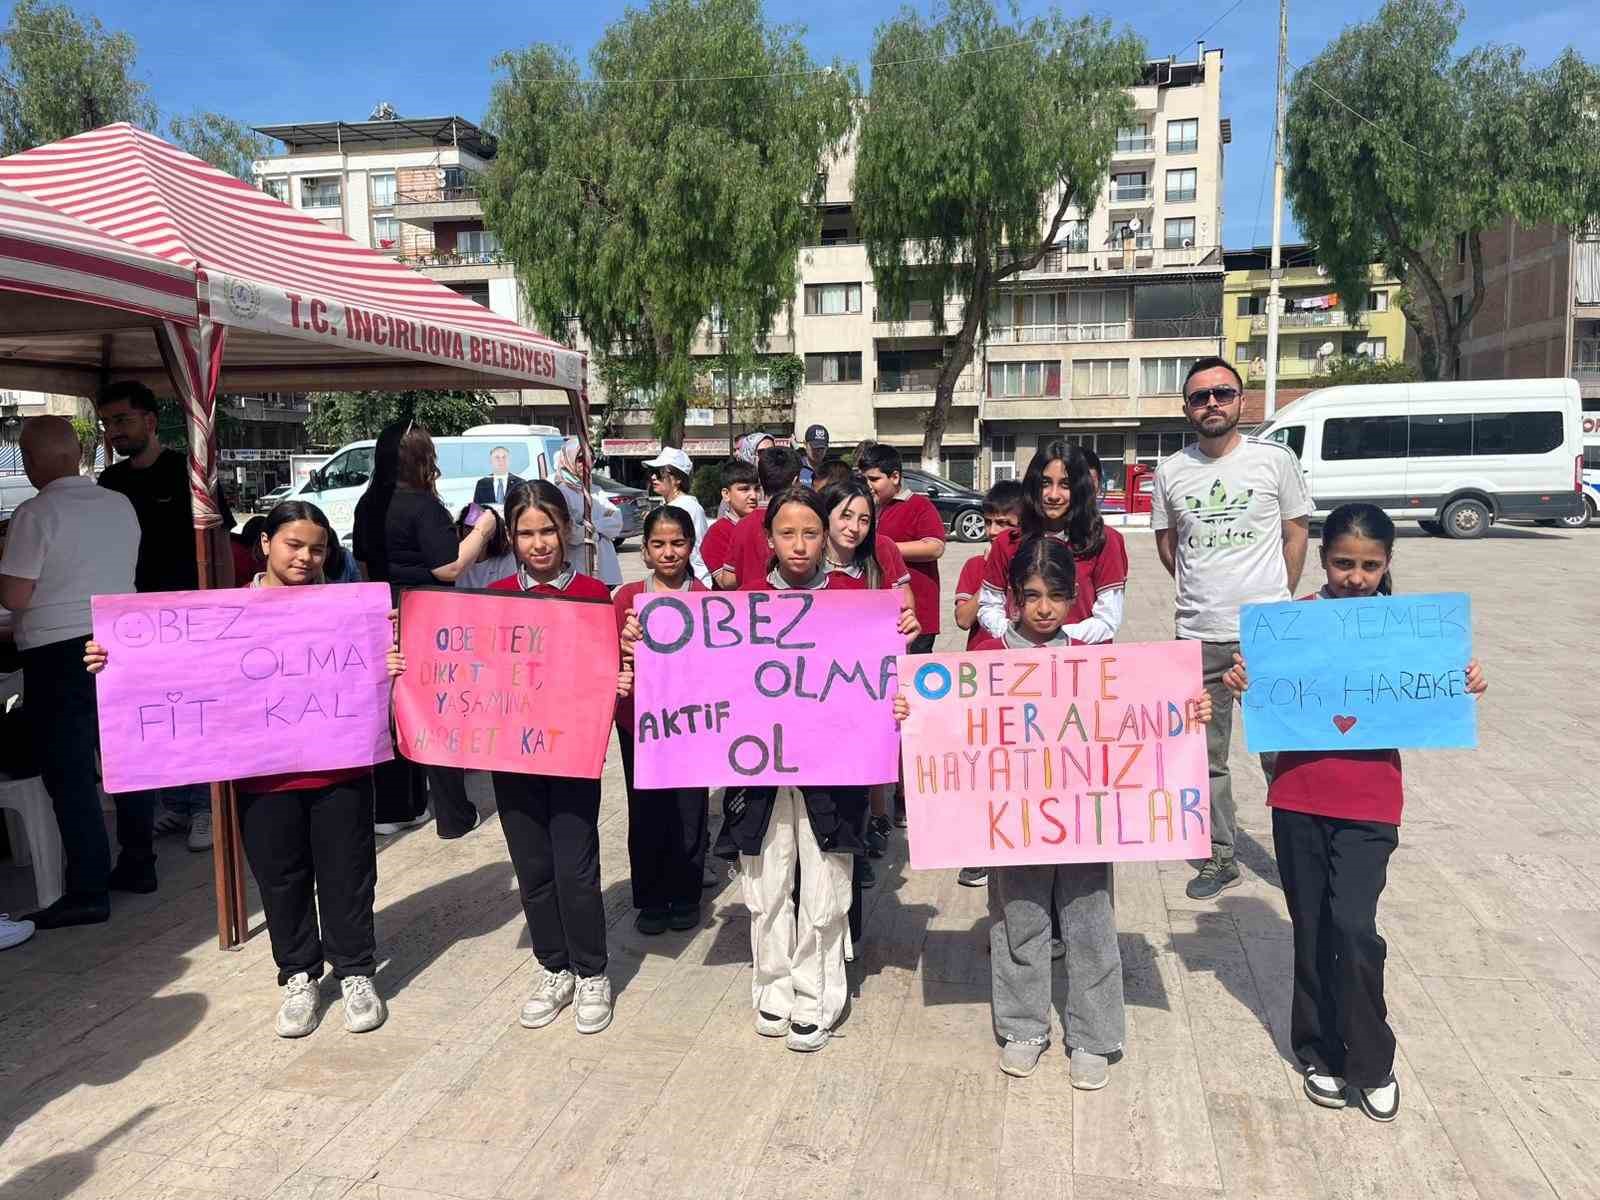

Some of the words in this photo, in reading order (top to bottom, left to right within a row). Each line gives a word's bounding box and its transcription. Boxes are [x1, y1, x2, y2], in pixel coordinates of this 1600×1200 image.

[286, 292, 337, 336] T.C.
[470, 335, 556, 378] BELEDİYESİ
[113, 606, 251, 648] OBEZ
[638, 592, 816, 655] OBEZ
[1252, 609, 1304, 644] AZ
[1333, 604, 1467, 641] YEMEK
[240, 643, 368, 681] OLMA
[511, 660, 543, 690] ET,
[754, 655, 897, 703] OLMA
[913, 654, 1120, 700] OBEZİTE
[264, 692, 359, 728] KAL
[638, 700, 730, 743] AKTİF
[520, 727, 565, 755] KAT
[728, 723, 799, 776] OL
[916, 742, 1165, 794] HAYATINIZI
[988, 787, 1206, 850] KISITLAR
